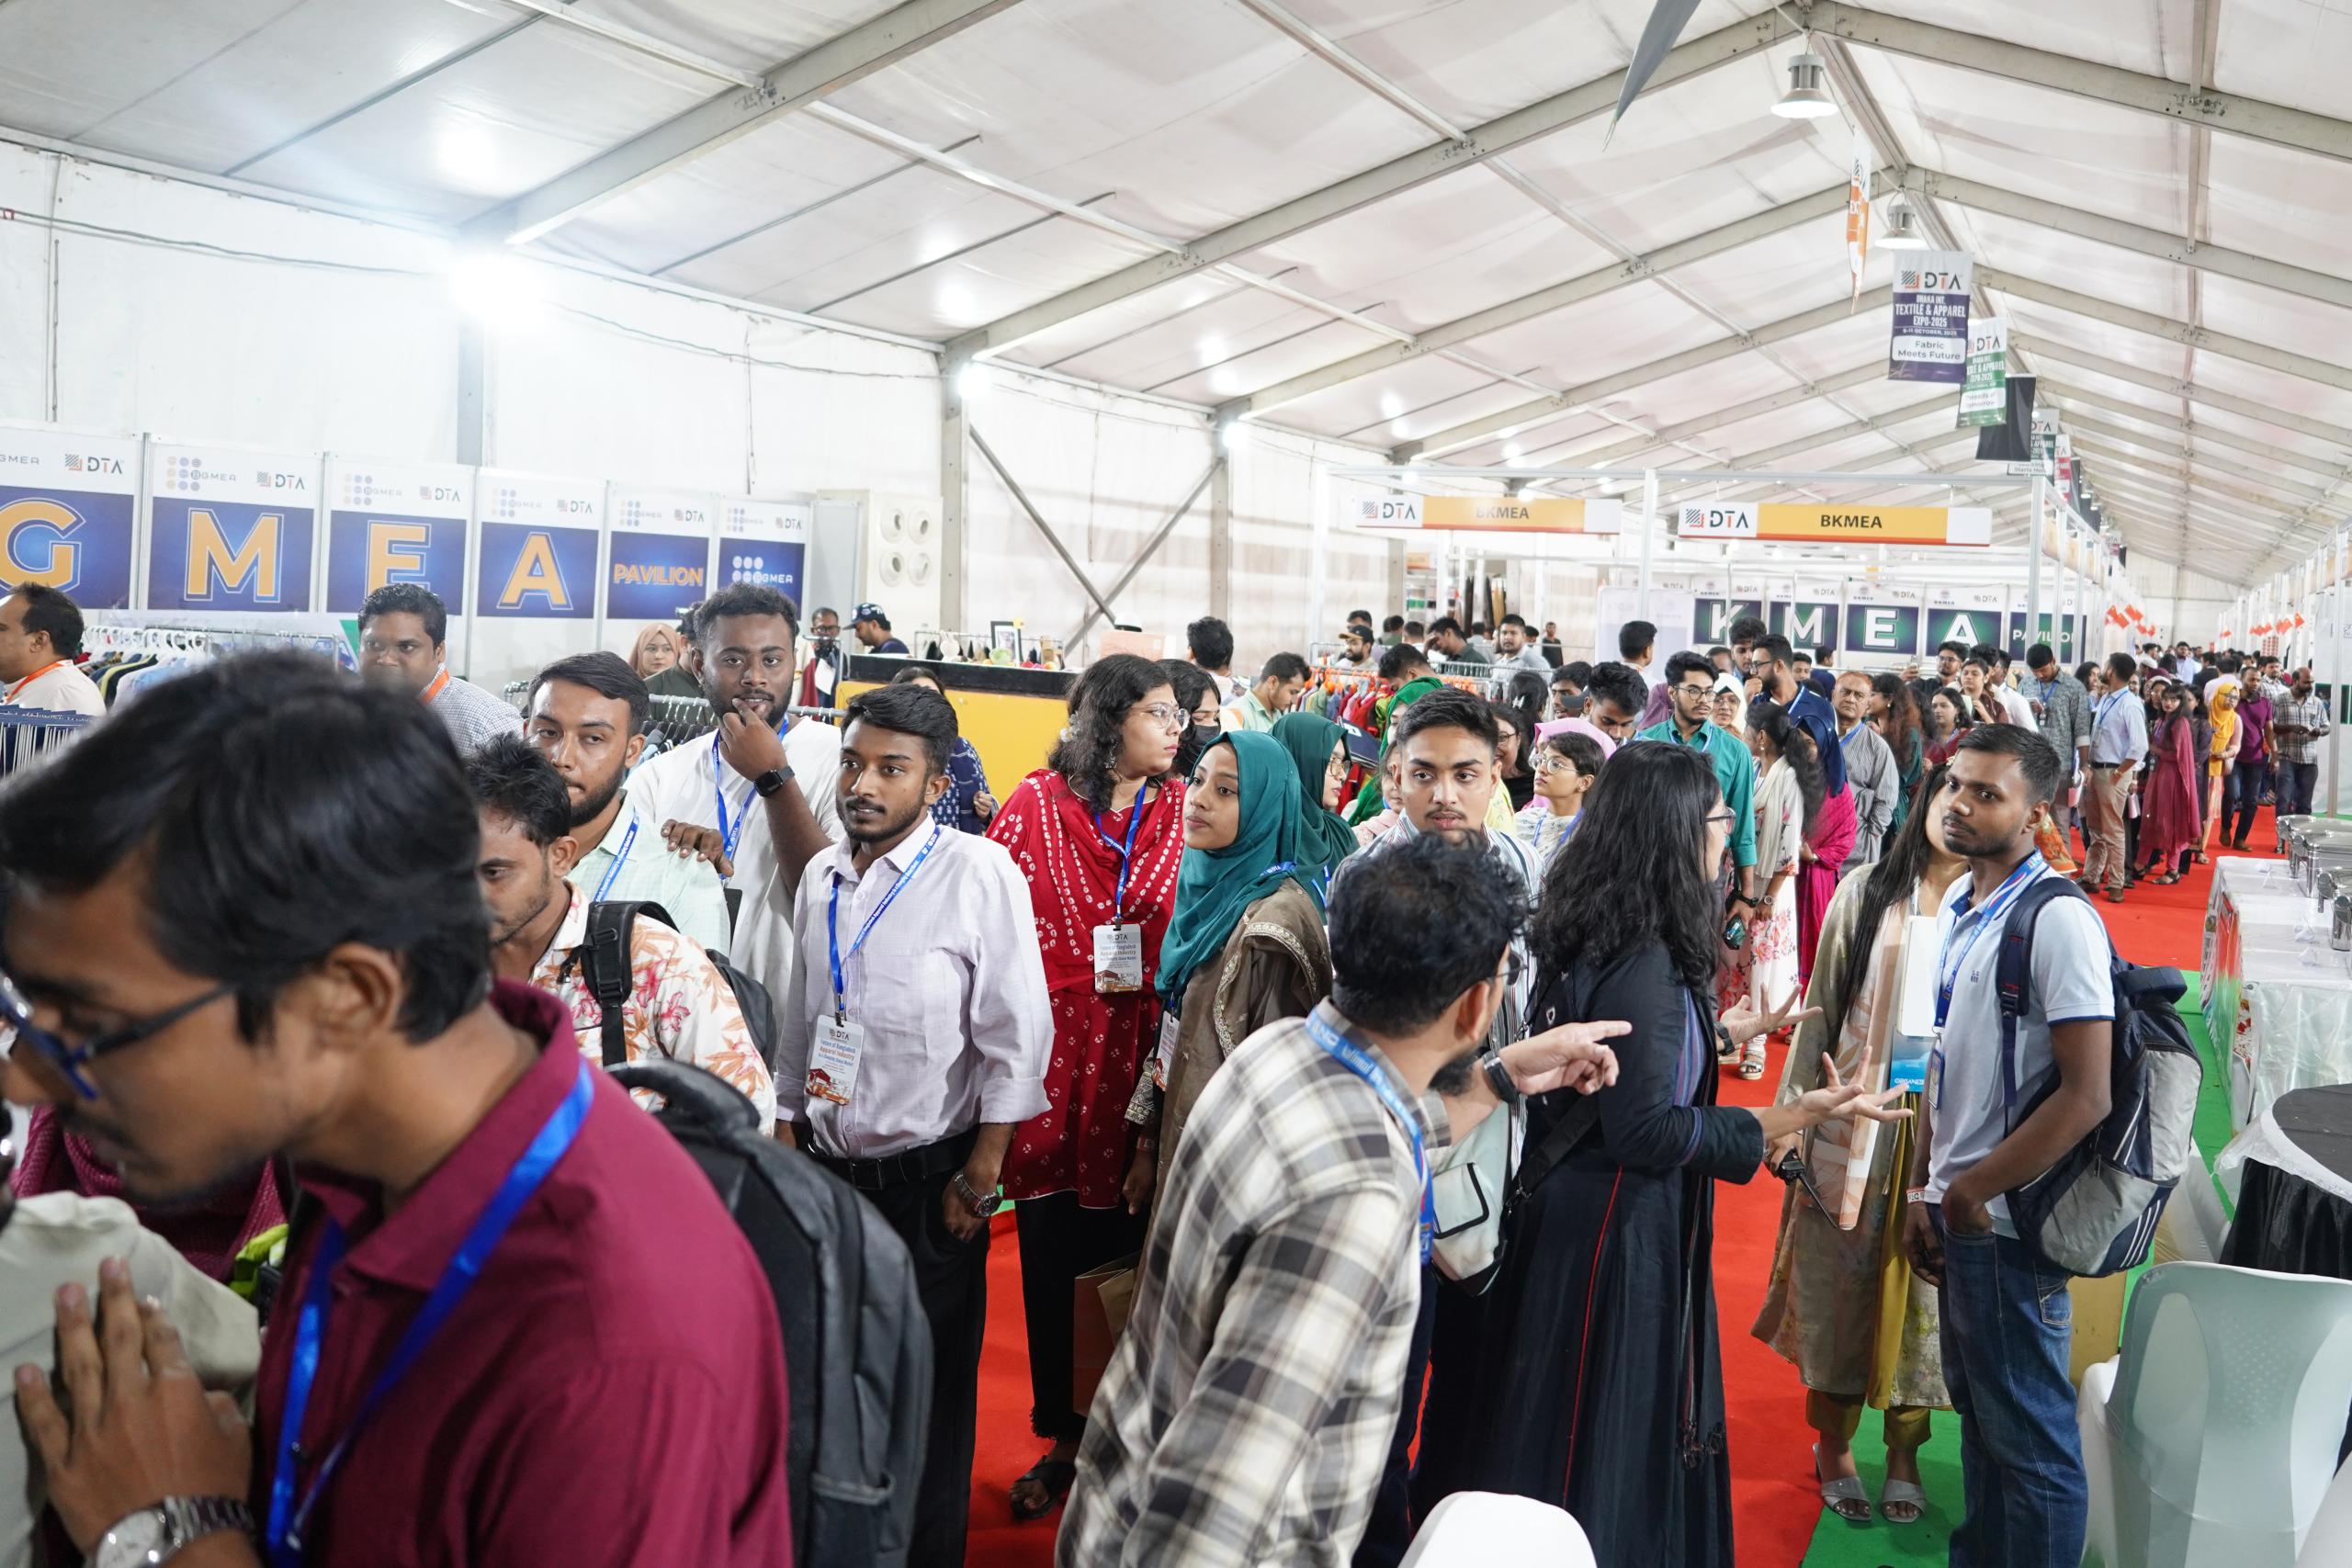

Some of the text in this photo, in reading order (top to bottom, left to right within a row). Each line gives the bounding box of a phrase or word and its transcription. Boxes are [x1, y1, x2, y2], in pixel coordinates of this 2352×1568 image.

[1924, 272, 1961, 290] DTA
[1895, 304, 1965, 317] TEXTILE & APPAREL
[1913, 316, 1947, 327] EXPO-2025
[1915, 341, 1944, 349] Fabric
[1977, 336, 2000, 351] DTA
[1897, 350, 1961, 359] Meets Future
[87, 457, 122, 474] DTA
[276, 473, 305, 490] DTA
[435, 488, 460, 502] DTA
[571, 500, 593, 513] DTA
[1383, 502, 1529, 520] DTA BKMEA
[685, 510, 705, 523] DTA
[1709, 511, 1883, 530] DTA BKMEA
[785, 518, 802, 530] DTA
[0, 497, 704, 610] G M E A PAVILION
[1783, 604, 1826, 646] M
[1863, 607, 1900, 649] E
[1941, 612, 1982, 647] A
